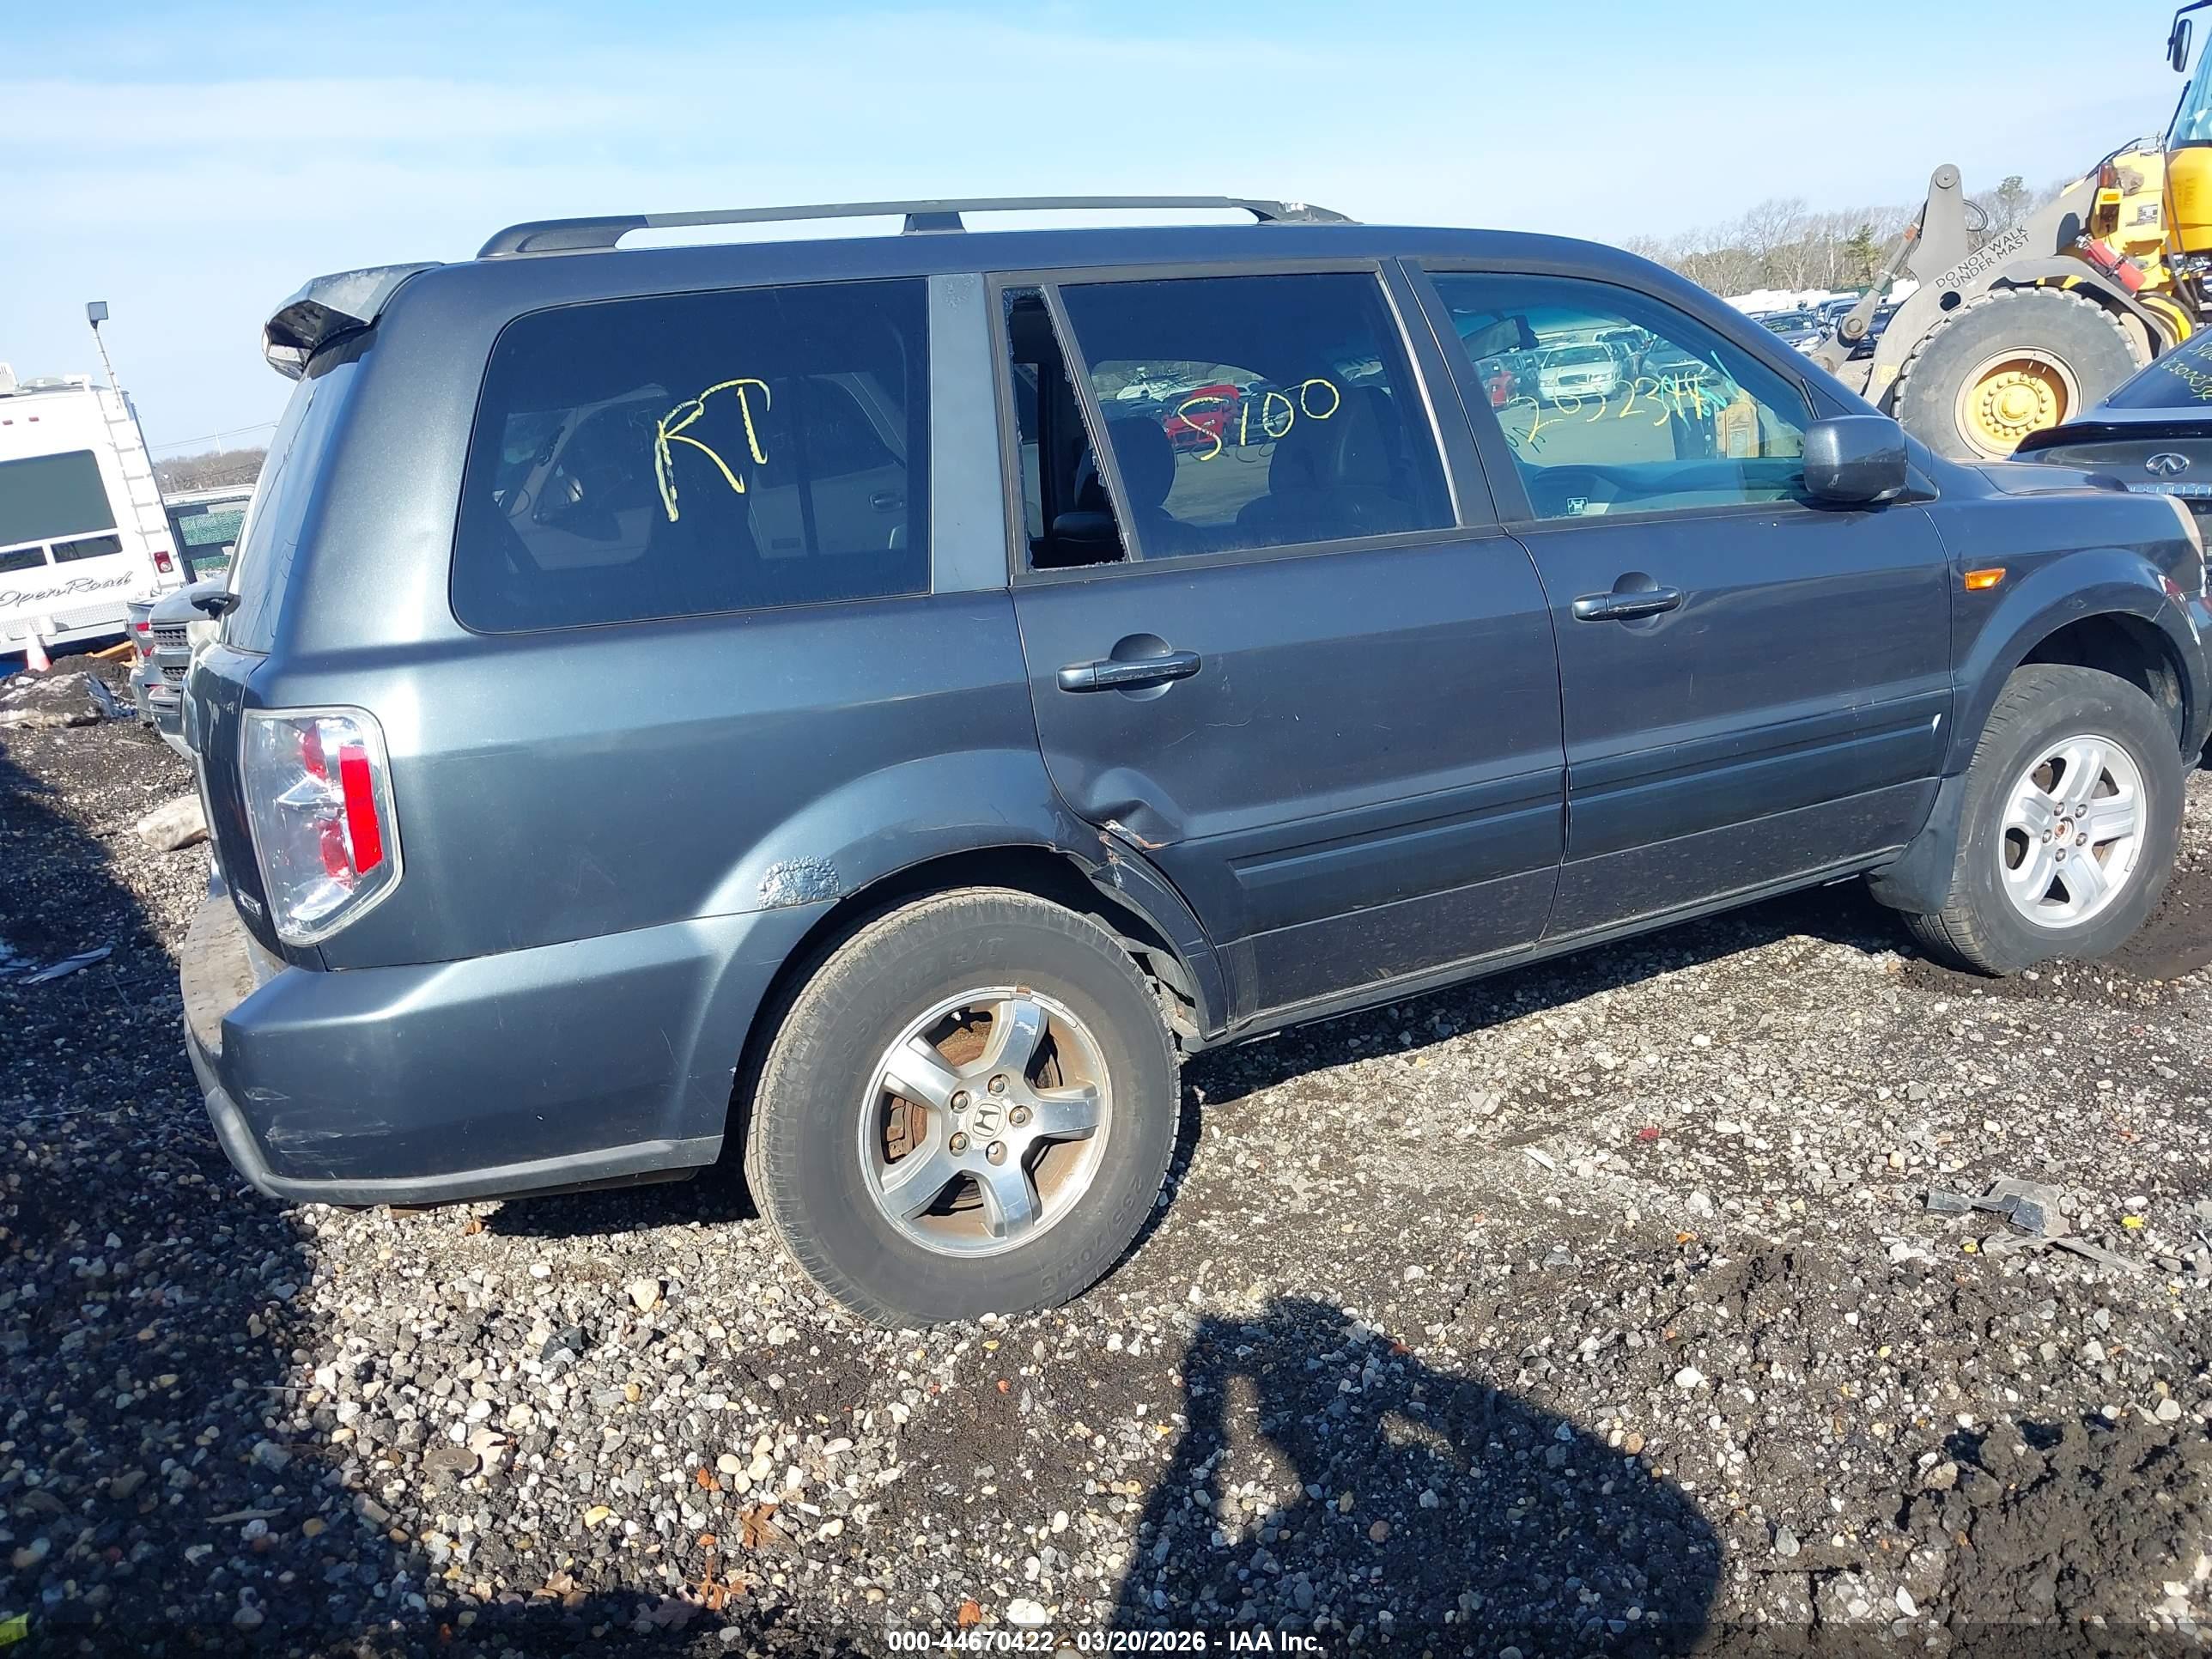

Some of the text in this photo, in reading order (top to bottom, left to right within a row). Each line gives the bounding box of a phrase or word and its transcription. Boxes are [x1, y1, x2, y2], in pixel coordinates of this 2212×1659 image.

[1936, 225, 2027, 288] DO NOT WALK
[1951, 233, 2030, 289] UNDER MAST
